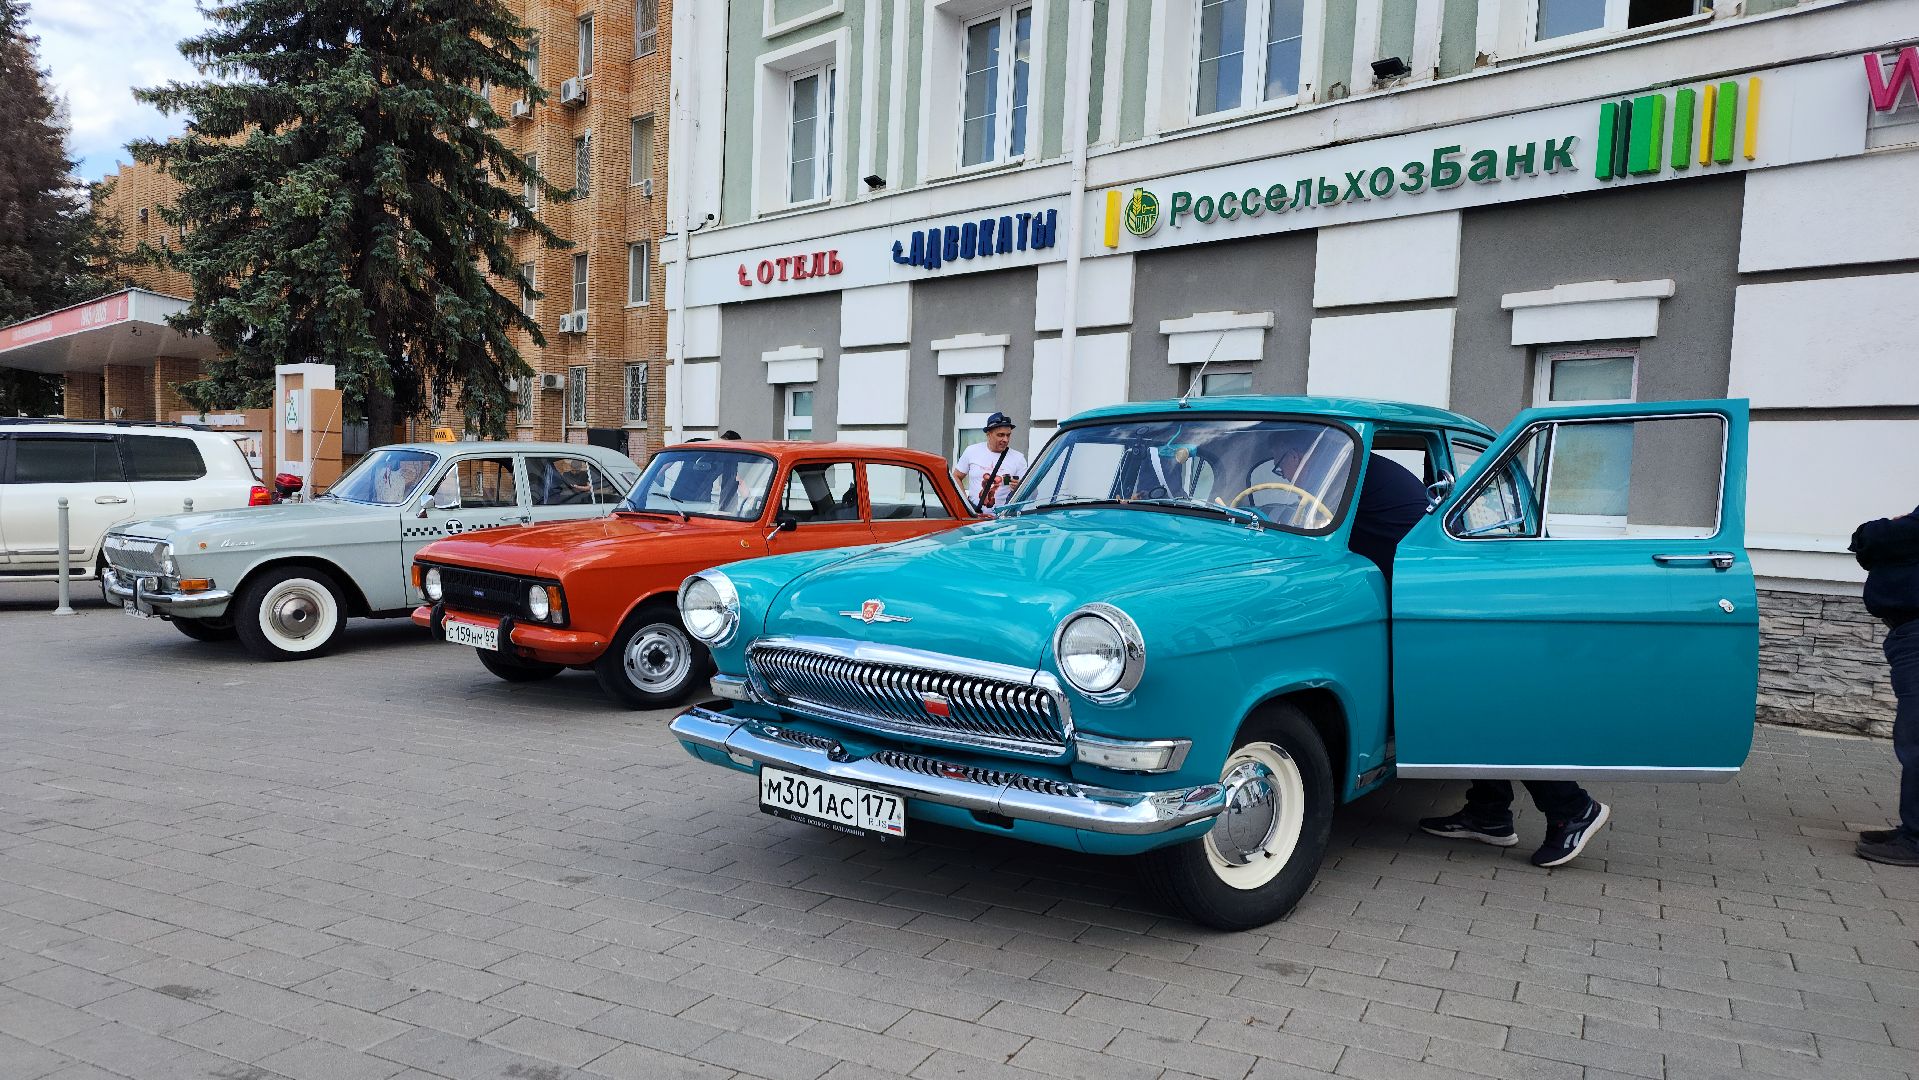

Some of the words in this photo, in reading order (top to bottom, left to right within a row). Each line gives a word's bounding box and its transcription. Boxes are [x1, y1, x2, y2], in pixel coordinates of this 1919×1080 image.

[1169, 135, 1579, 228] РоссельхозБанк
[907, 208, 1057, 270] АДВОКАТЫ
[756, 249, 843, 285] ОТЕЛЬ
[767, 776, 854, 820] М301АС
[860, 793, 897, 820] 177
[868, 817, 888, 829] RUS
